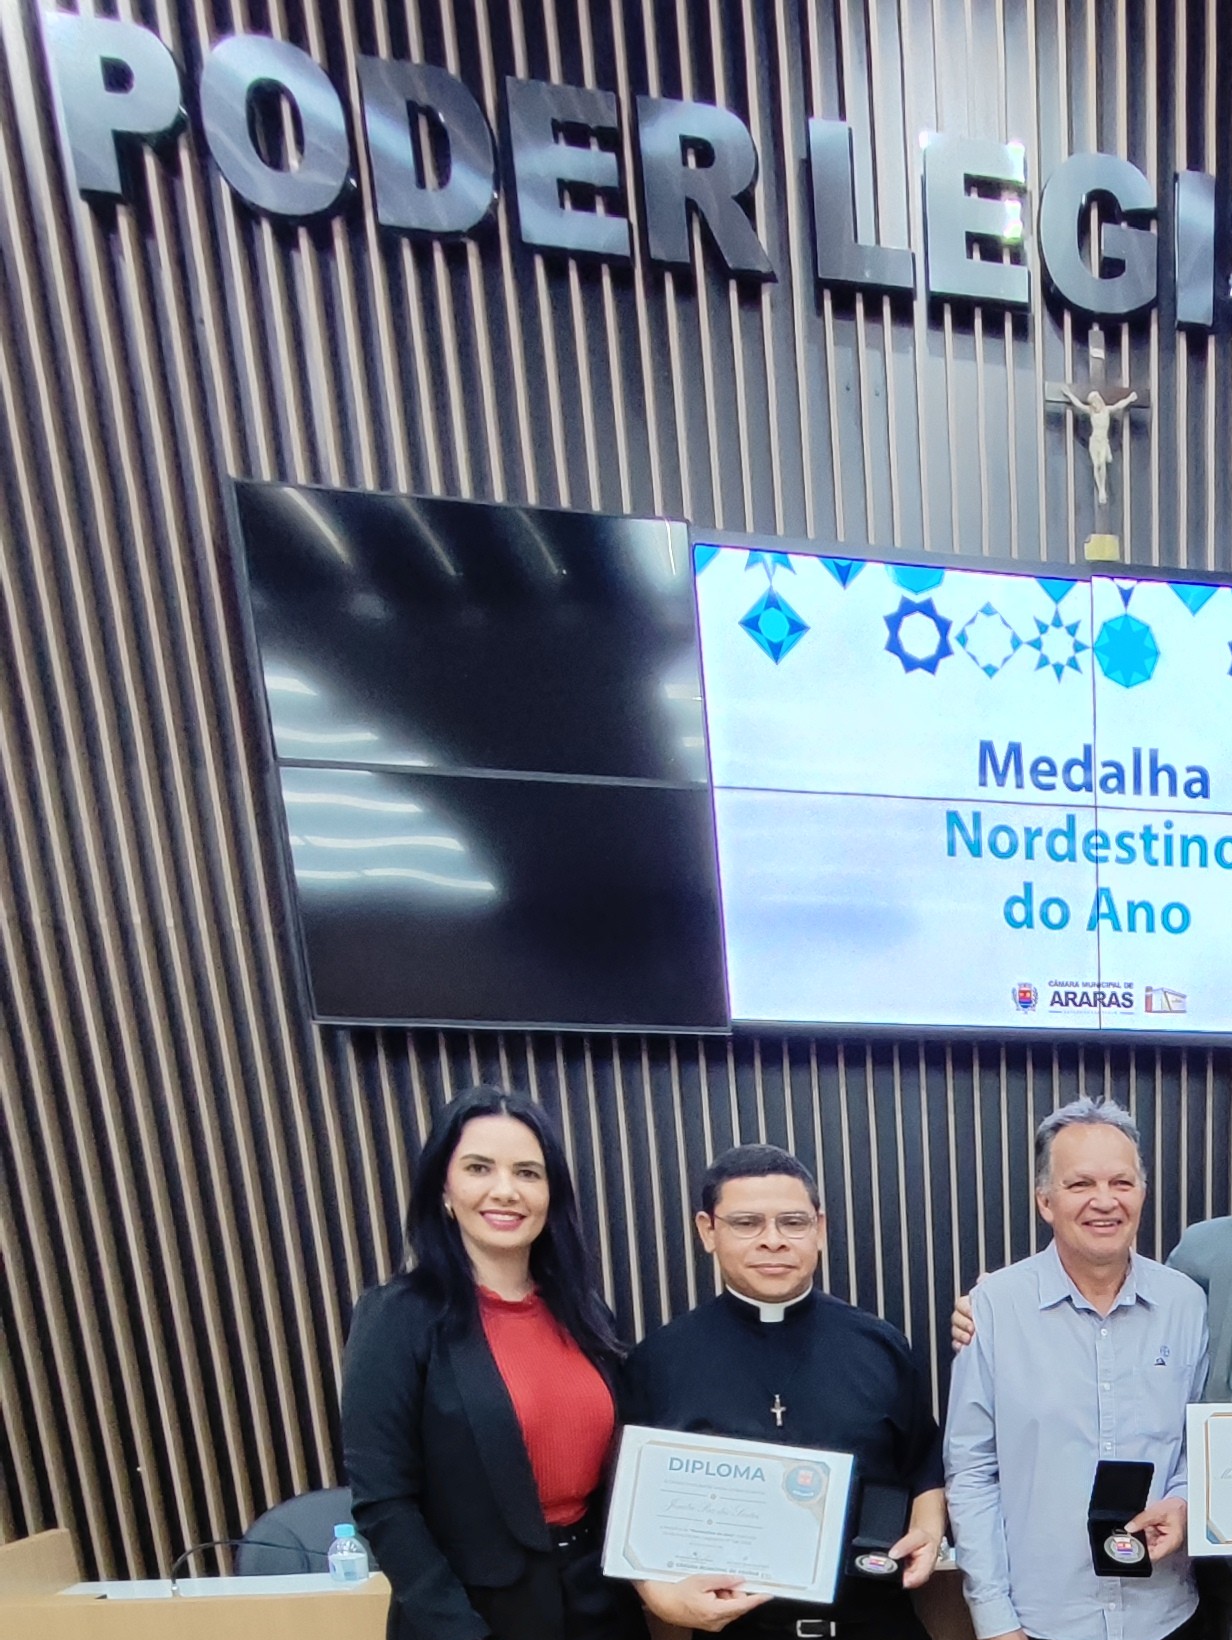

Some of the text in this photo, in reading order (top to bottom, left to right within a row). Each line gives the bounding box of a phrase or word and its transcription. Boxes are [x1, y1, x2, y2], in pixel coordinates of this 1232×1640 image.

[41, 10, 776, 281] PODER
[978, 739, 1211, 800] Medalha
[1003, 881, 1192, 935] do Ano
[1048, 979, 1080, 988] CÂMARA
[1124, 981, 1134, 989] DE
[1050, 991, 1134, 1008] ARARAS
[668, 1457, 765, 1481] DIPLOMA
